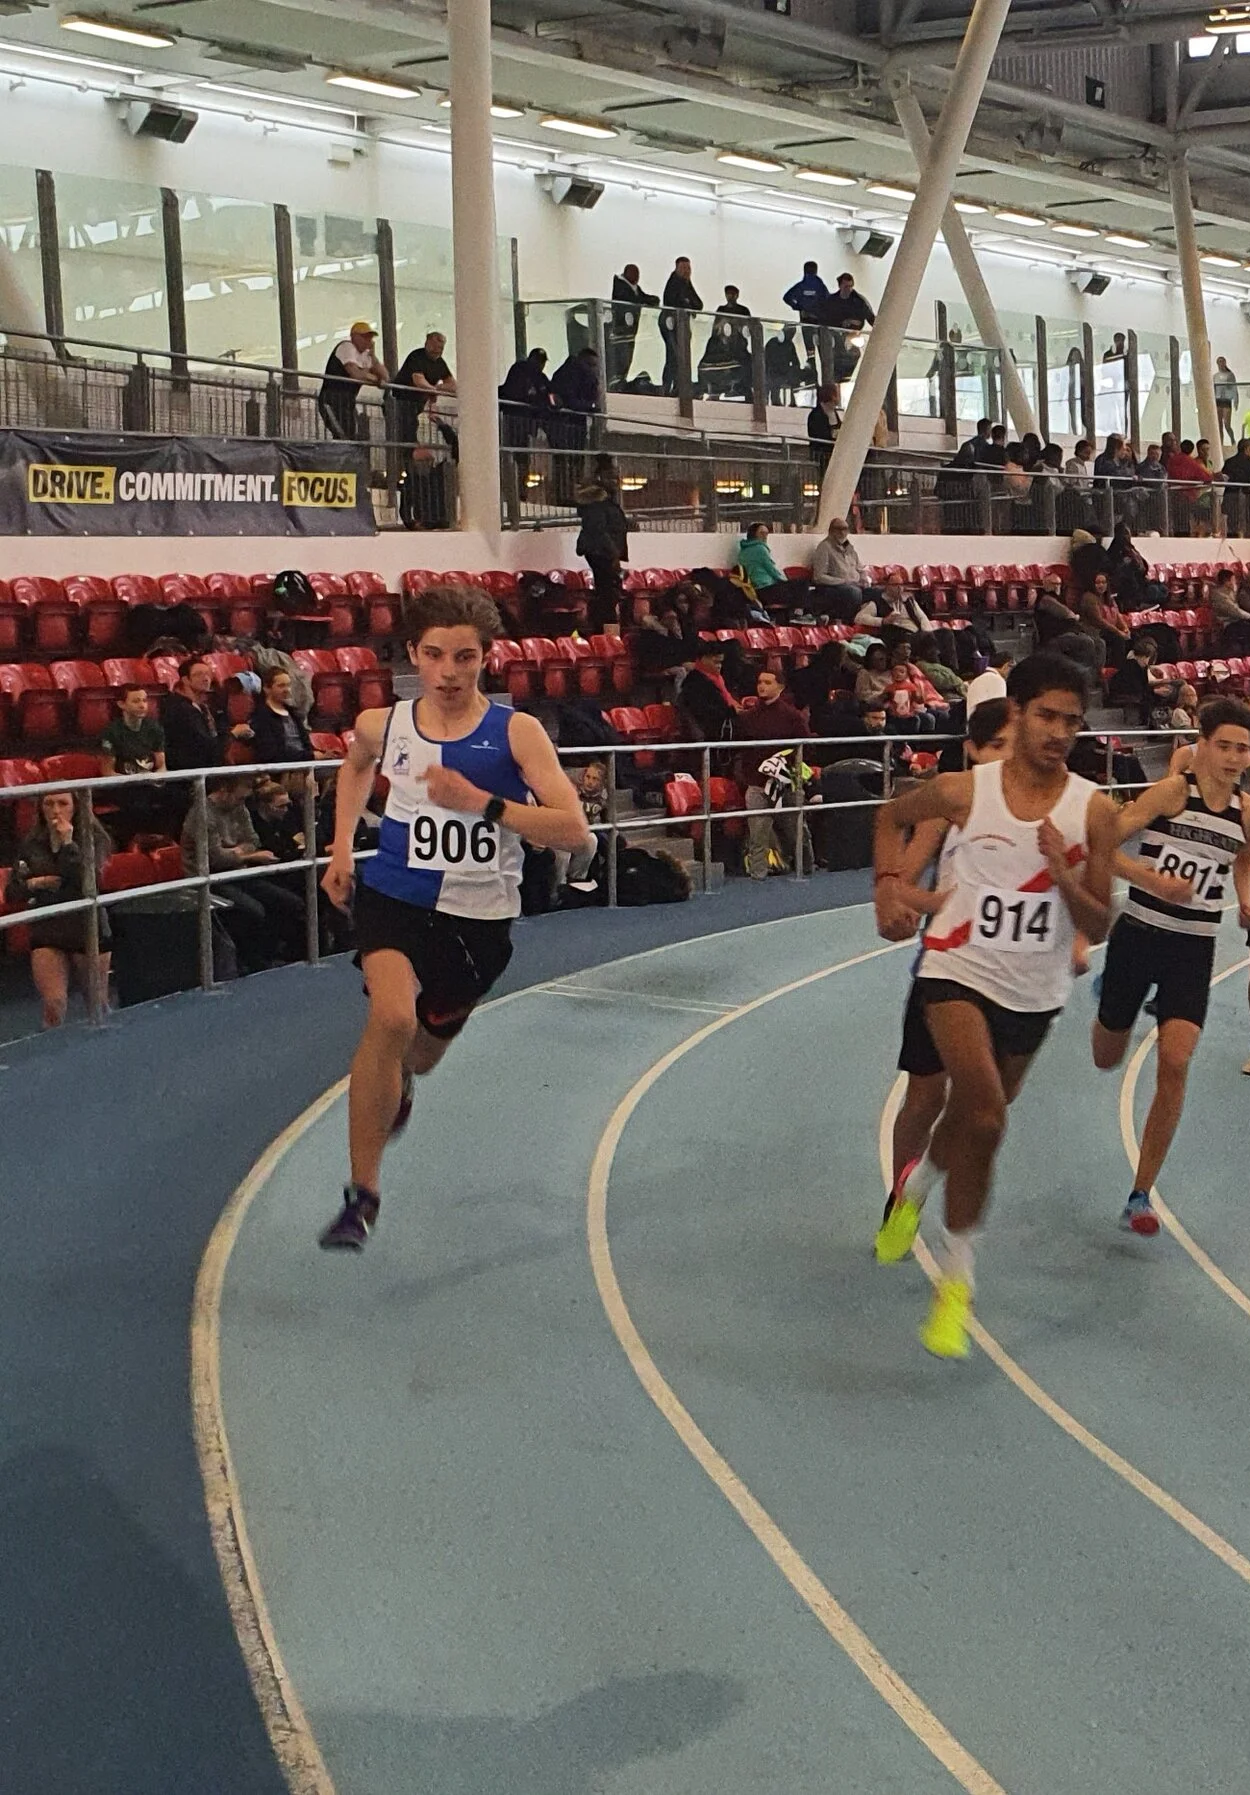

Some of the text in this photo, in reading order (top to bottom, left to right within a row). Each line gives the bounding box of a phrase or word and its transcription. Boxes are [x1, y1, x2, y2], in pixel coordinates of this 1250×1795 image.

[32, 469, 354, 504] DRIVE. COMMITMENT. FOCUS.
[414, 815, 497, 863] 906
[1160, 853, 1212, 894] 891
[979, 895, 1052, 942] 914
